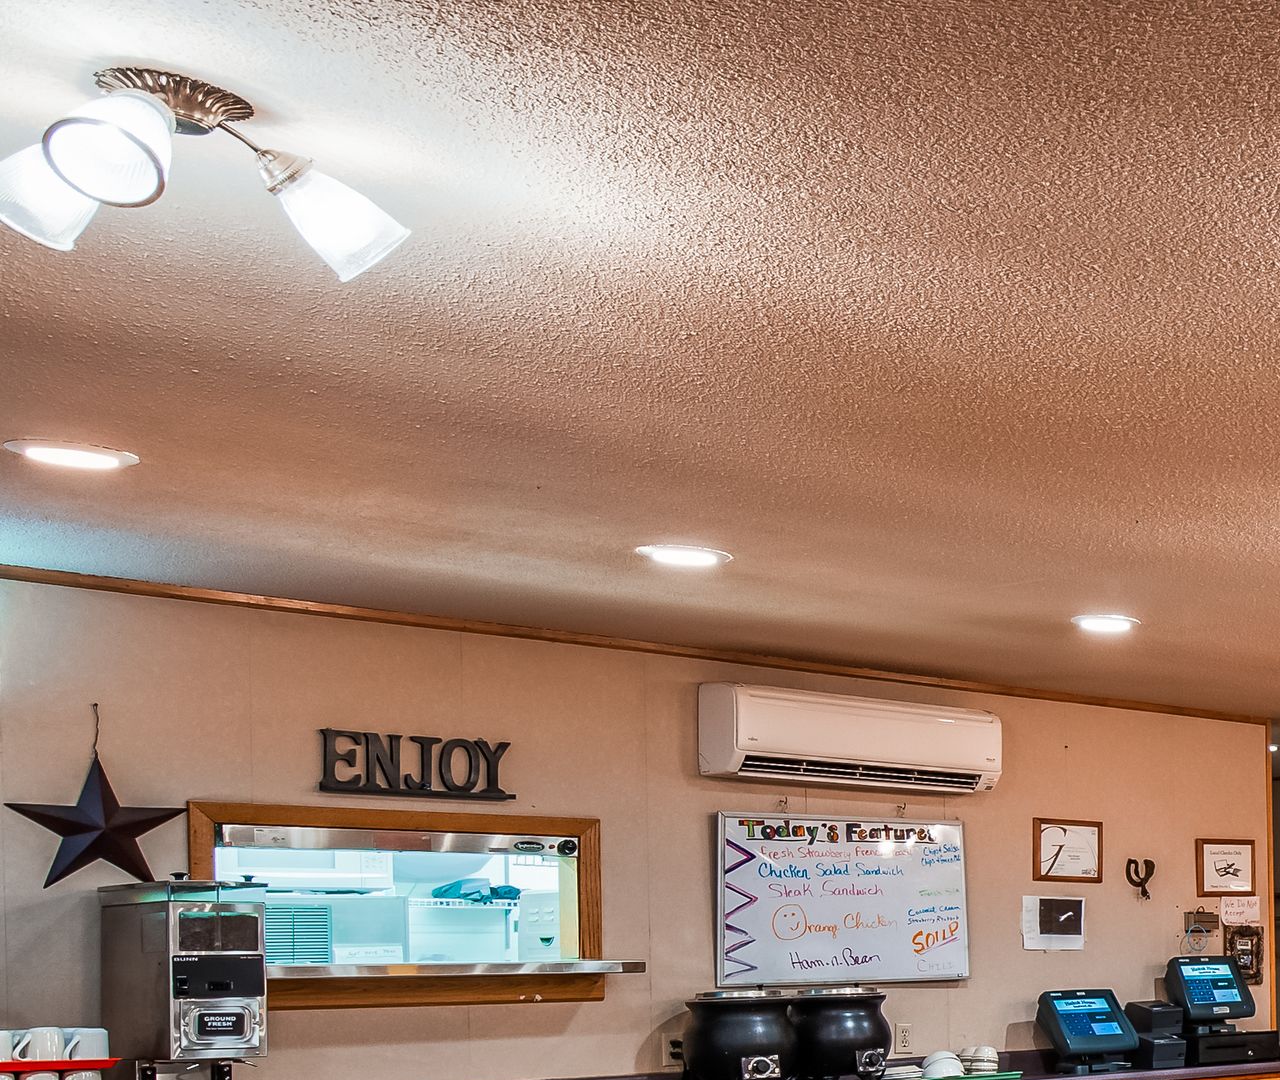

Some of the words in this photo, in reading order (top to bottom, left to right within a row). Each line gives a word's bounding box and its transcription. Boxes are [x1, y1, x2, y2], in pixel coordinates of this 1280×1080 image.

[319, 729, 512, 795] ENJOY
[738, 819, 840, 846] Today's
[854, 845, 886, 857] Frenc
[758, 862, 811, 880] Chicken
[815, 862, 851, 878] Salad
[855, 862, 904, 877] Sandwich
[768, 883, 813, 898] Steak
[820, 880, 884, 898] Sandwich
[844, 912, 898, 930] Chicken
